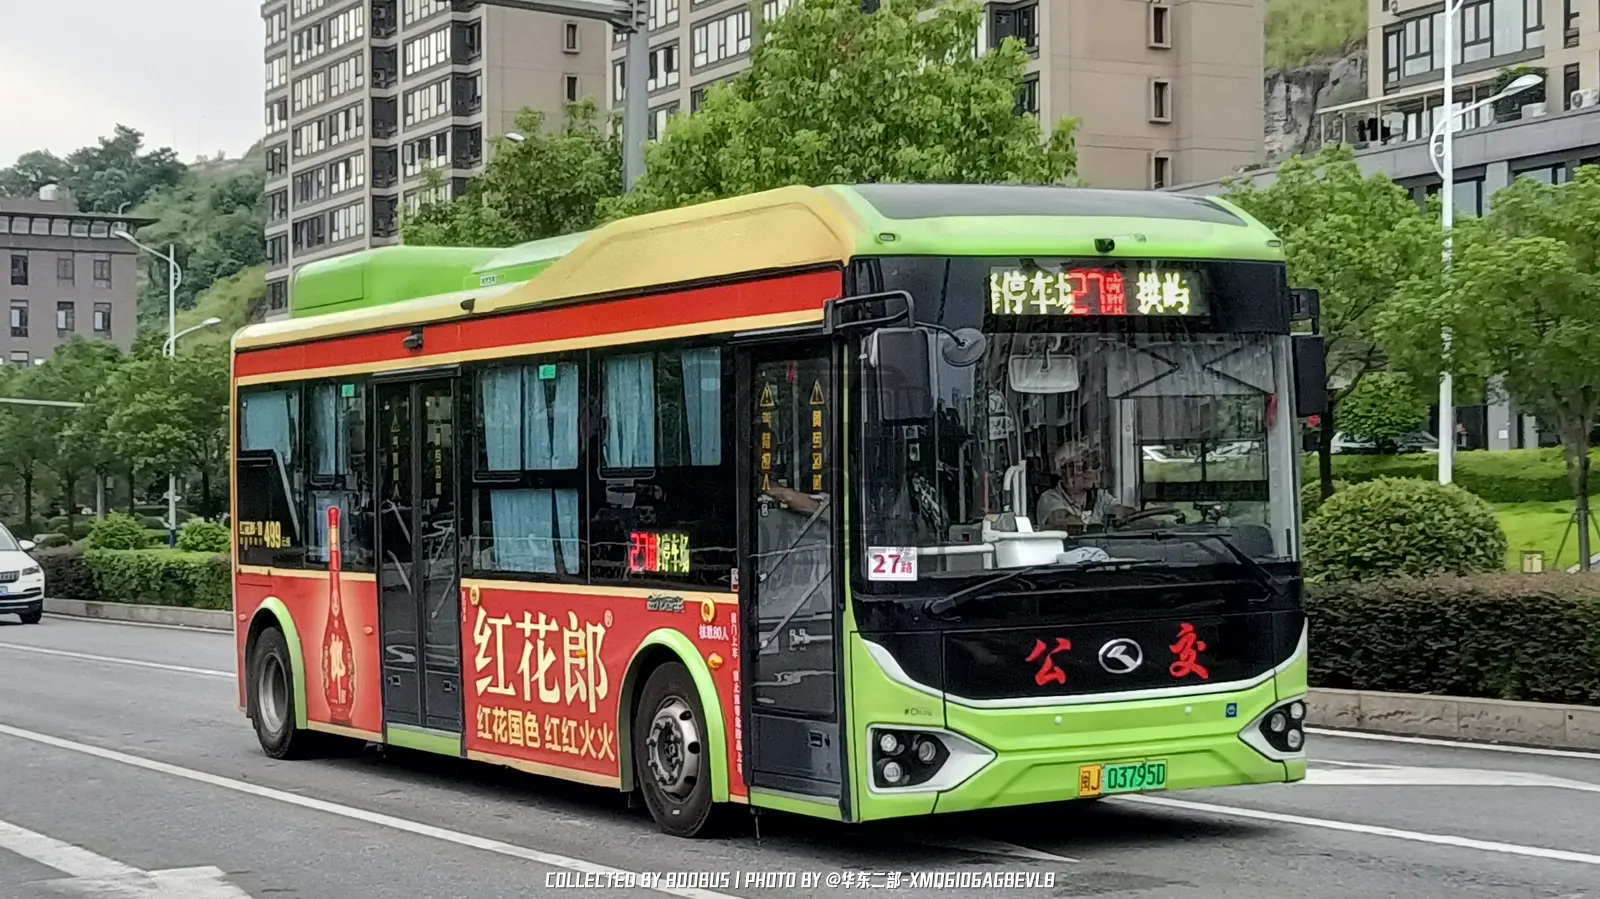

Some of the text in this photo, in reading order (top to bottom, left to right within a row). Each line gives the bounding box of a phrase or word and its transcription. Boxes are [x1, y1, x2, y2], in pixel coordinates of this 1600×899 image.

[872, 553, 912, 574] 27路
[473, 605, 609, 713] 红花郎
[1025, 622, 1209, 686] 公 交
[476, 704, 616, 762] 红花国色 红红火火
